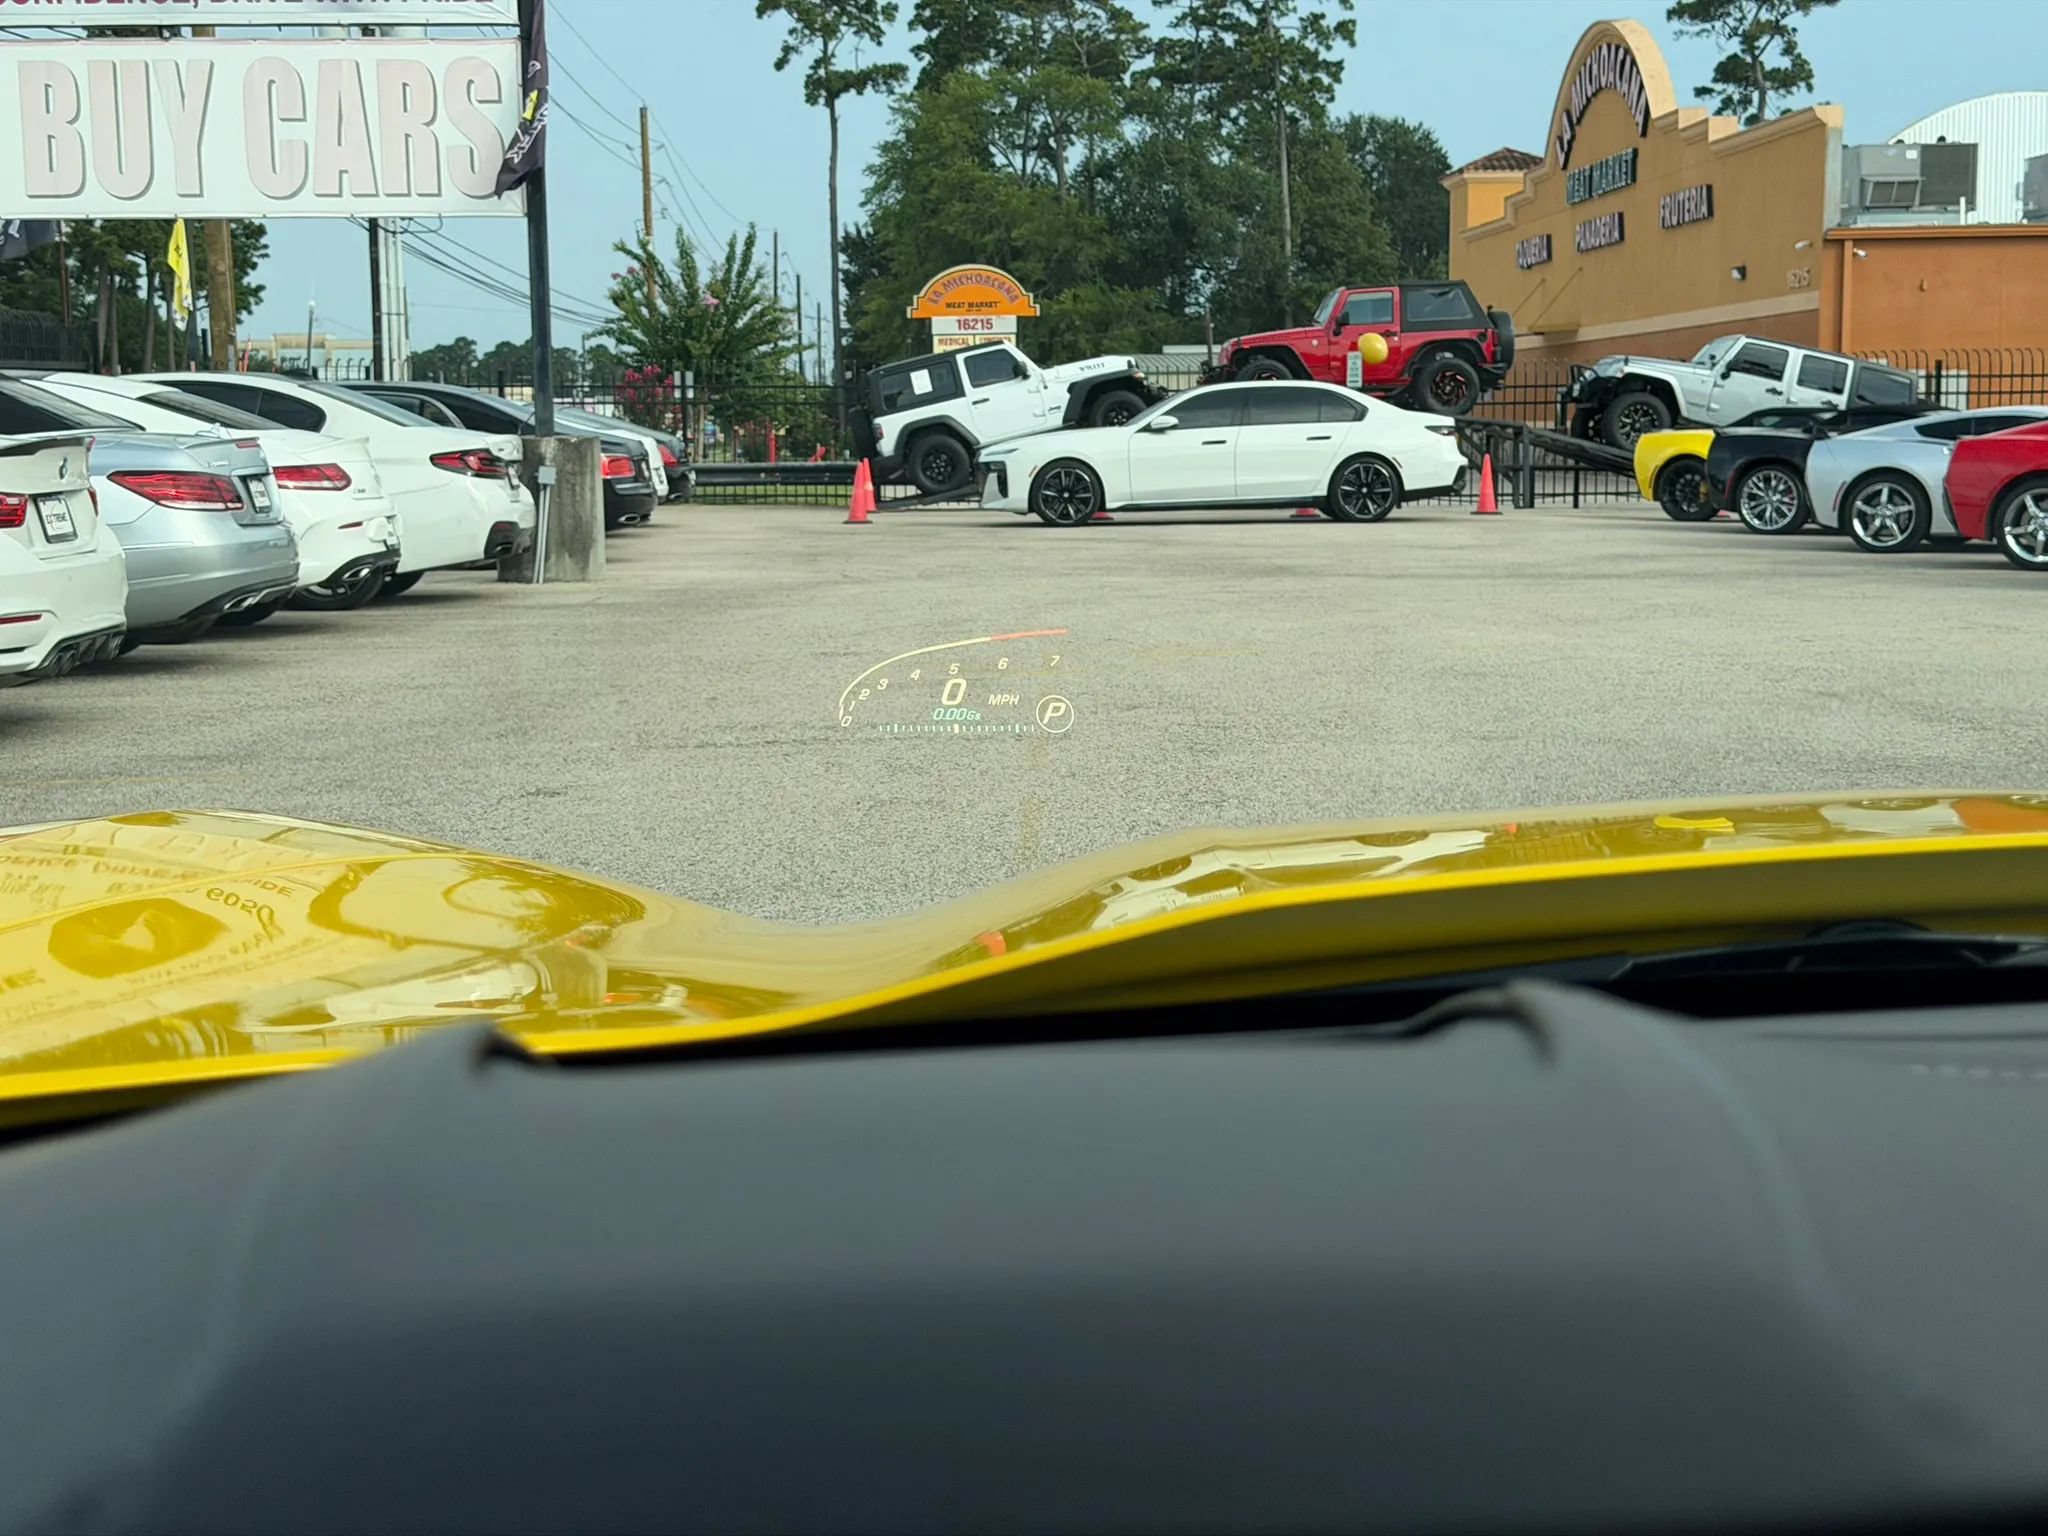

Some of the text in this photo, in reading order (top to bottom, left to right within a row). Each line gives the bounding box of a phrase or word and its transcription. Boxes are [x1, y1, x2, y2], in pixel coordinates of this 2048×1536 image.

[17, 60, 214, 200] BUY
[243, 56, 505, 199] CARS
[1556, 43, 1647, 170] LA MICHOACANA
[1566, 148, 1637, 205] MEAT MARKET
[1660, 184, 1713, 229] FRUTERIA
[1576, 212, 1624, 253] PANADERIA
[956, 318, 994, 331] 16215
[967, 301, 999, 309] MARKET
[841, 655, 1061, 727] 0 1 2 3 4 5 6 7
[941, 678, 1020, 706] 0 MPH
[1042, 702, 1067, 725] P
